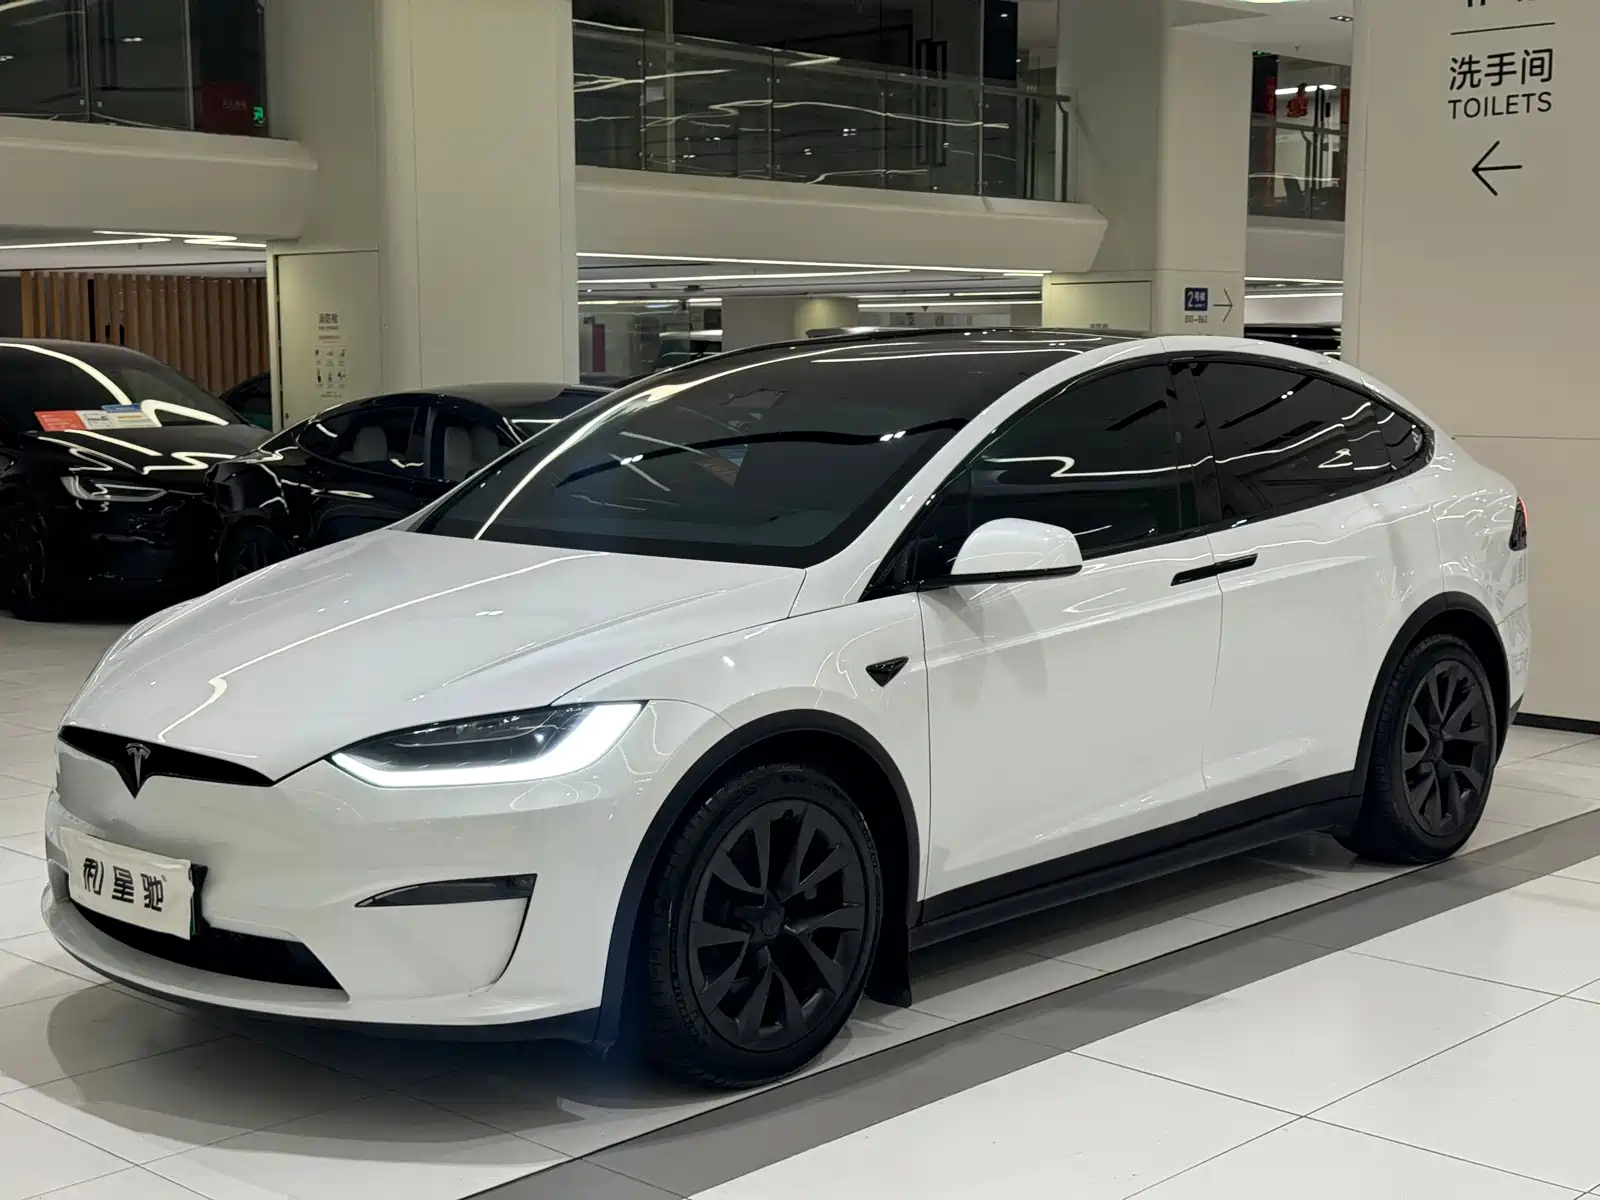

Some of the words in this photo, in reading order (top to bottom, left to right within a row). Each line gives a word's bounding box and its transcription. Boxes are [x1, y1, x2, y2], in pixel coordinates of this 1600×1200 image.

[1449, 48, 1553, 91] 洗手间
[1447, 91, 1553, 120] TOILETS
